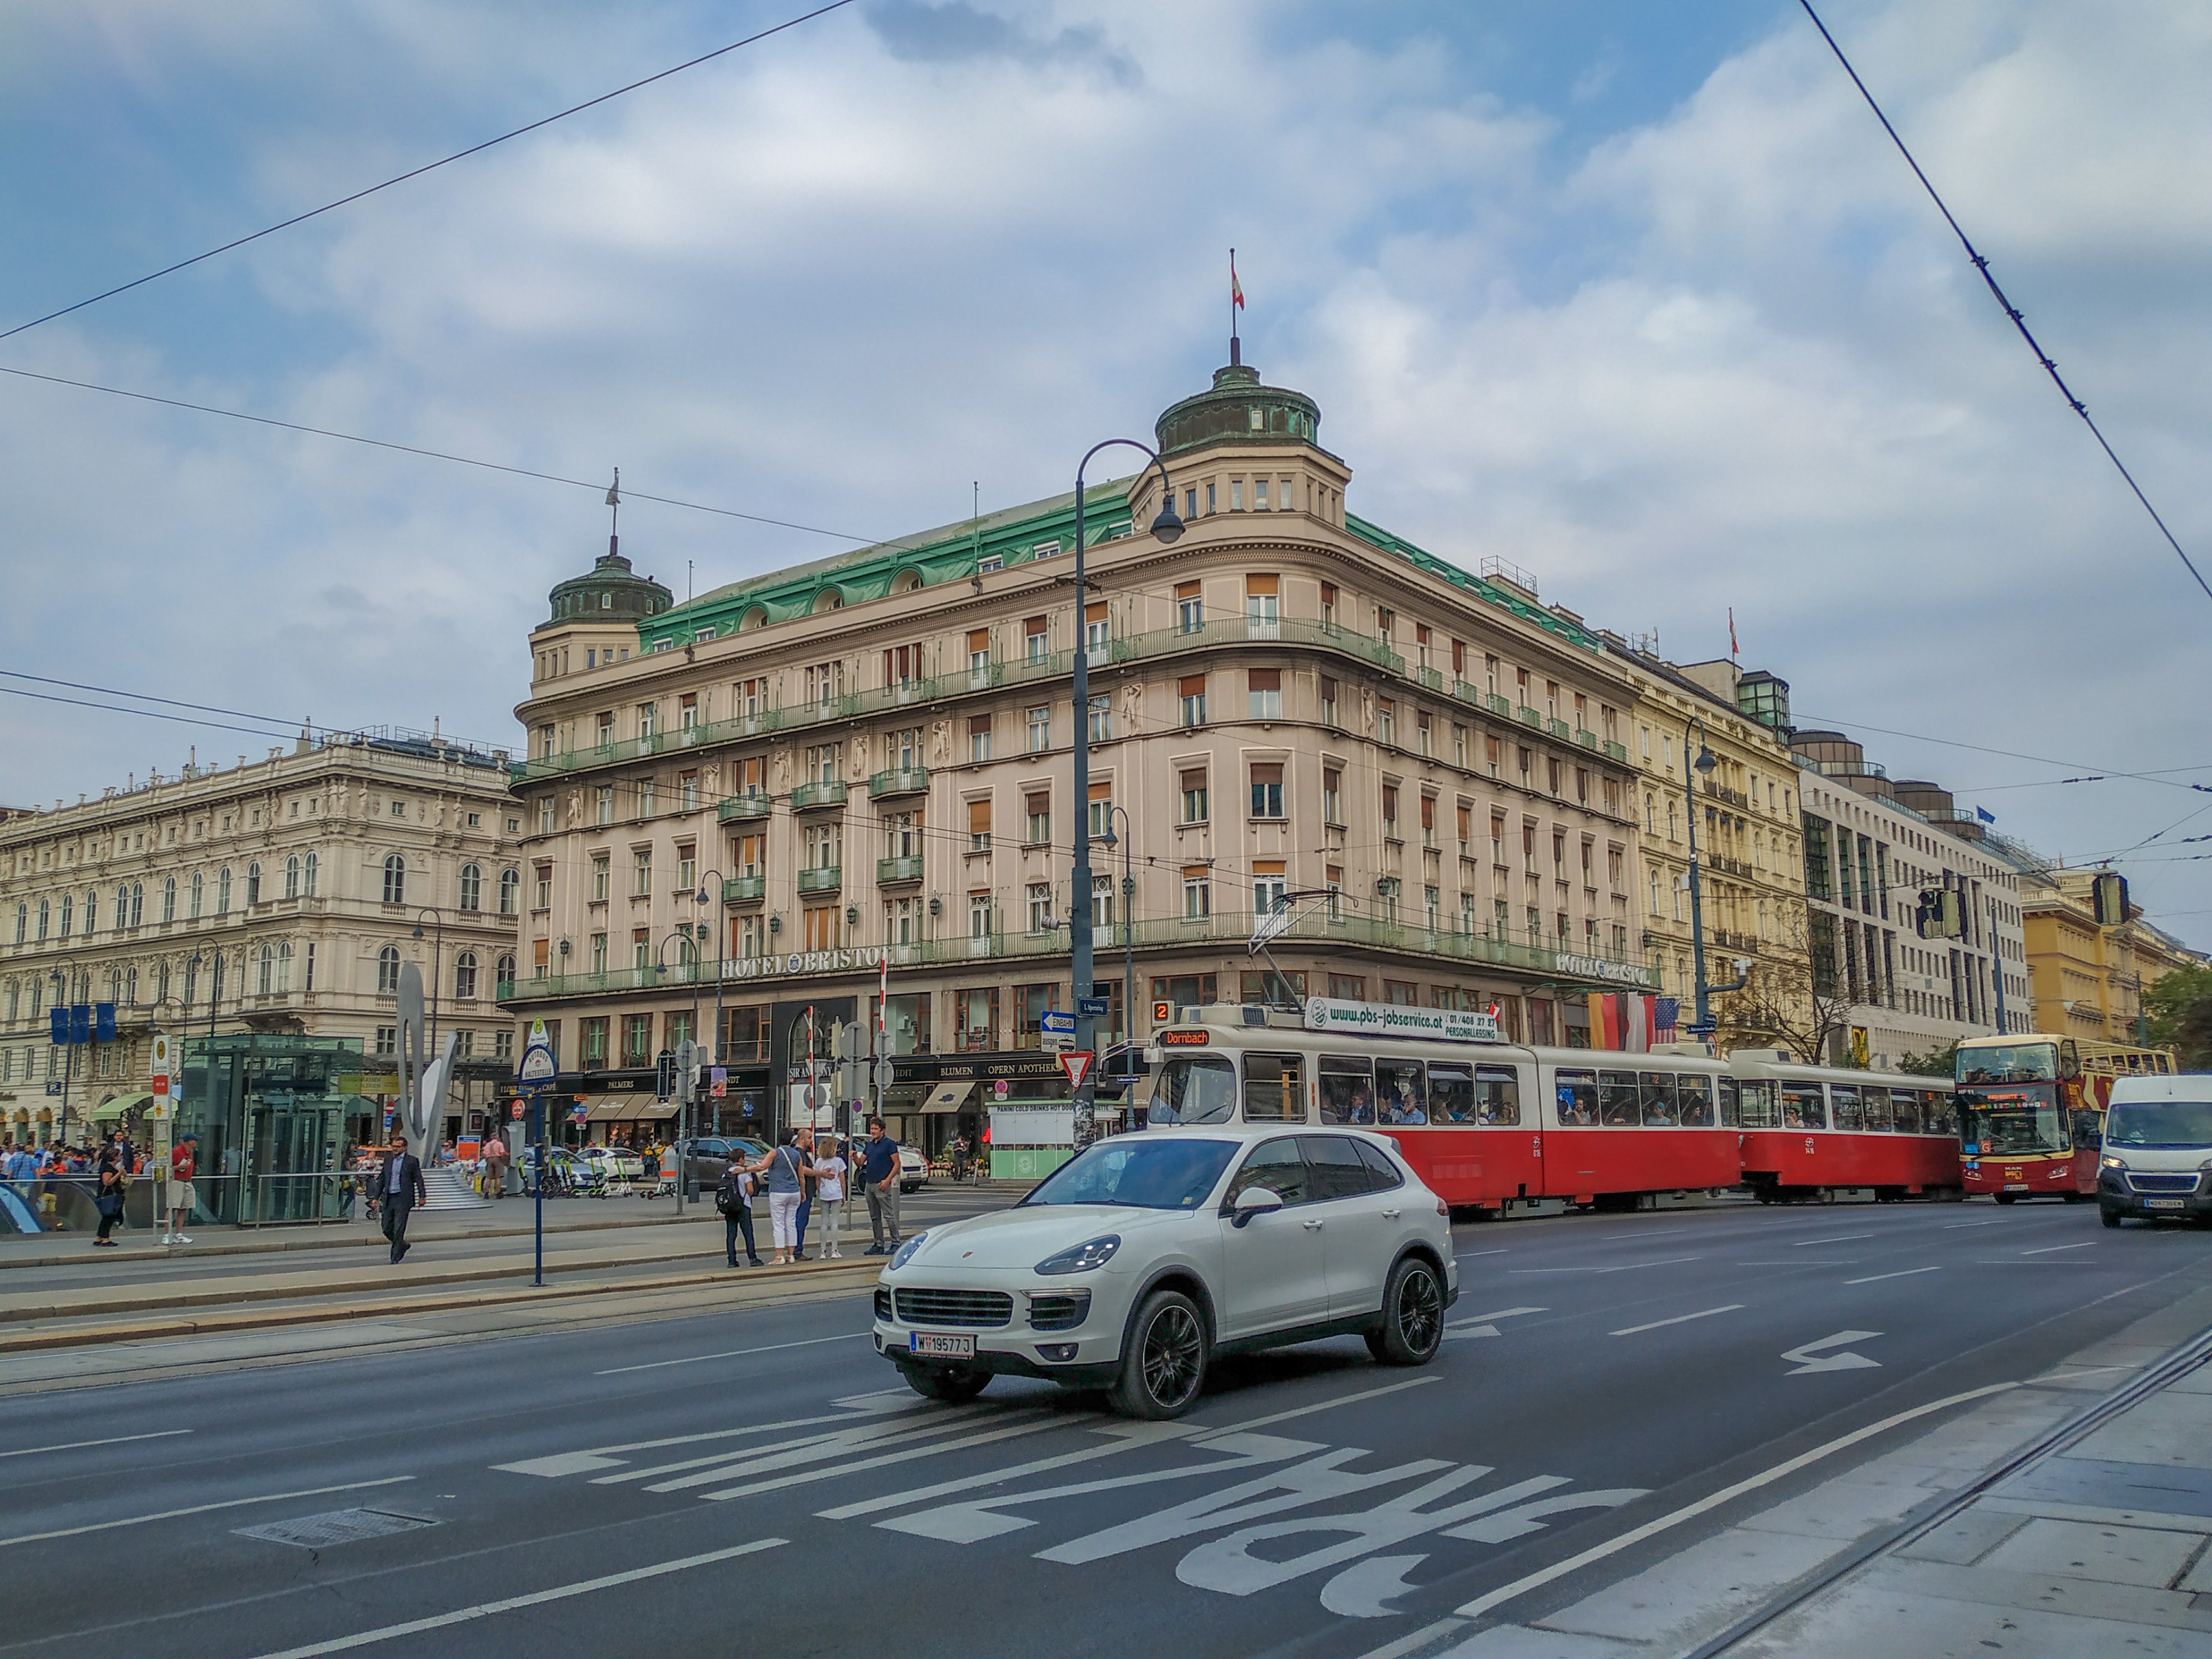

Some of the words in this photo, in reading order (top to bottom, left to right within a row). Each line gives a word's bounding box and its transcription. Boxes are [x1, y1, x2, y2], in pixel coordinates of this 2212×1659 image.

[722, 956, 786, 978] HOTEL
[804, 946, 895, 971] BRISTOL
[1556, 954, 1597, 977] HOTEL
[1604, 963, 1651, 985] BRISTOL
[1158, 1006, 1166, 1018] 2
[1331, 1006, 1443, 1029] www.pbs-jobservice.at
[1053, 1018, 1073, 1028] EINBAHN
[1450, 1014, 1474, 1025] 01/408
[1477, 1018, 1485, 1027] 27
[1488, 1018, 1495, 1027] 27
[1167, 1032, 1208, 1044] Dornbach
[528, 1051, 548, 1063] AUTOBUS
[525, 1068, 552, 1078] HALTESTELLE
[790, 1067, 800, 1077] SIR
[941, 1067, 974, 1076] BLUMEN
[988, 1065, 1015, 1074] OPERN
[542, 1083, 557, 1091] CAFÉ
